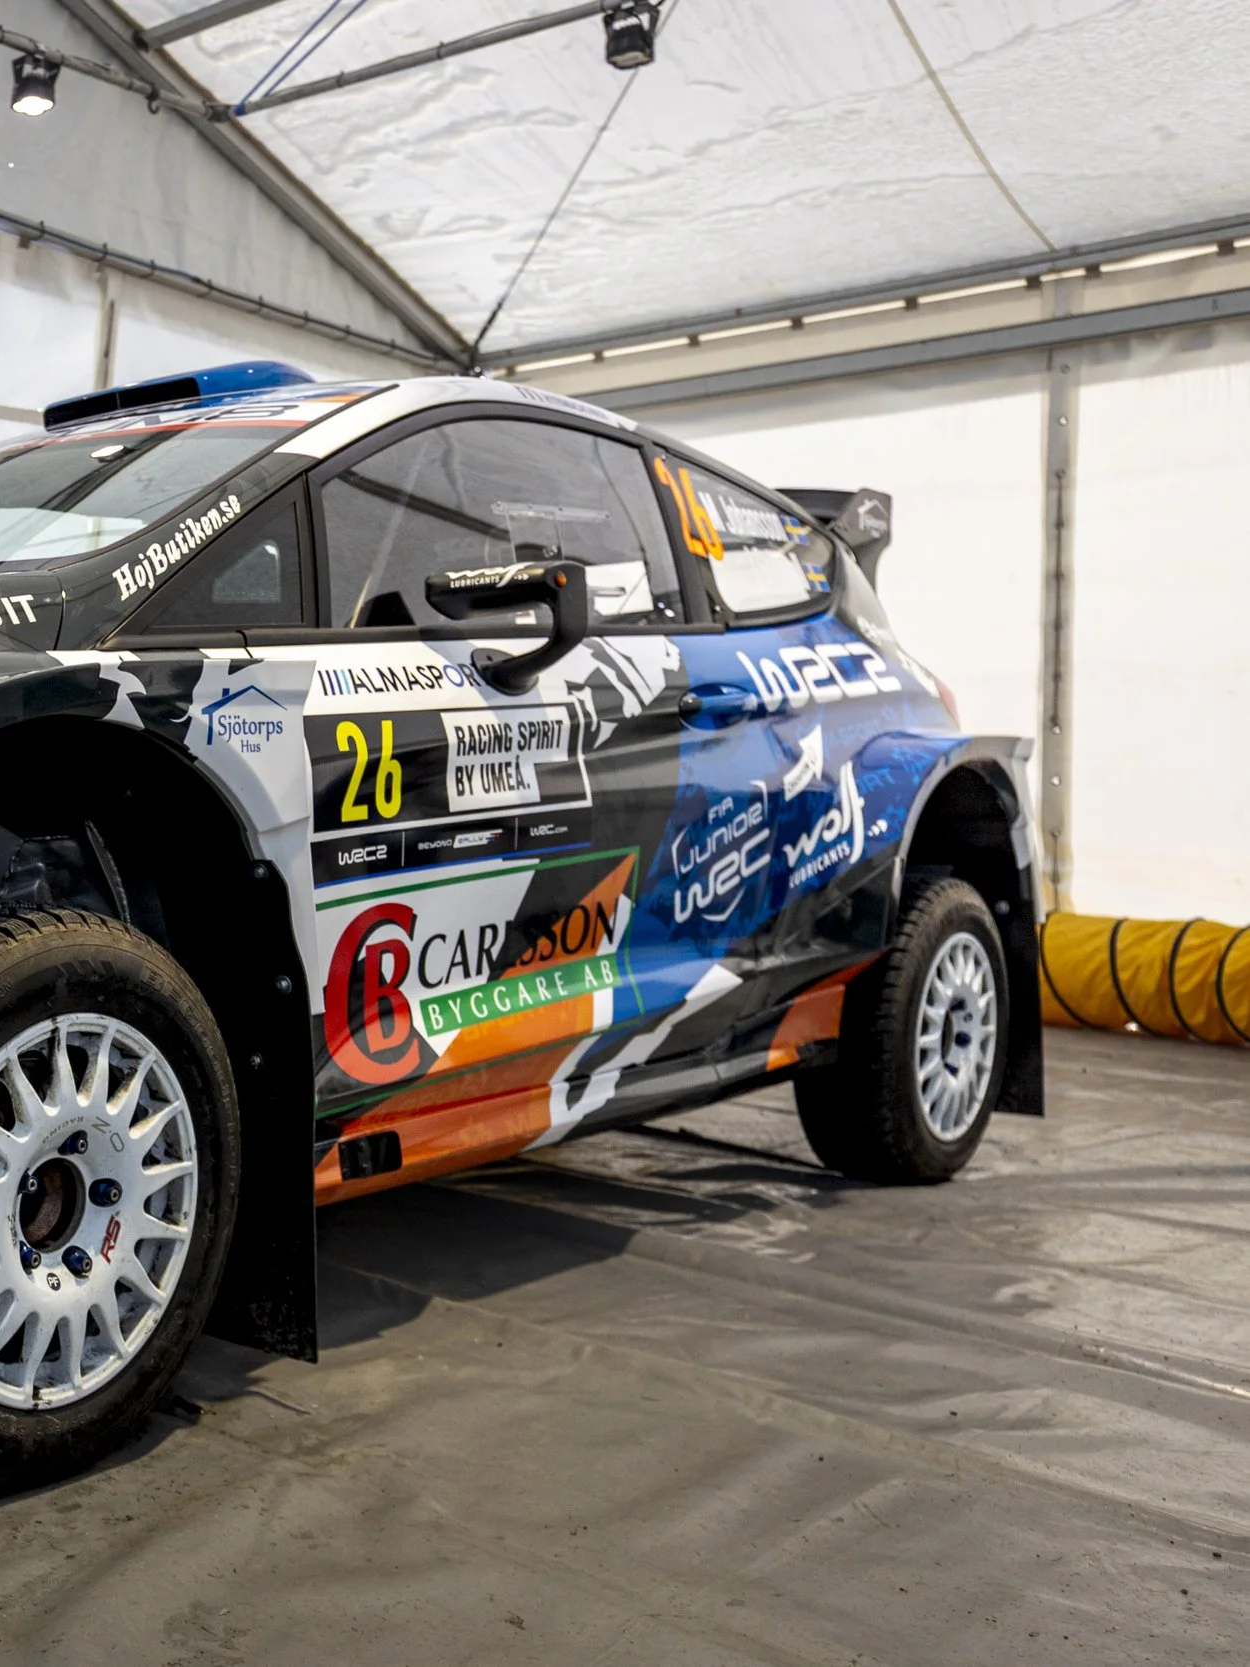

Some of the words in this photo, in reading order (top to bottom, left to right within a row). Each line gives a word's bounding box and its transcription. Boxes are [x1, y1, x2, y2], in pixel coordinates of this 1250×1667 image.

[112, 495, 241, 602] HojButiken.se
[450, 574, 500, 588] LUBRICANTS
[1, 594, 37, 625] IT
[350, 662, 488, 694] ALMASPOR
[217, 713, 283, 743] Sjötorps
[454, 723, 513, 757] RACING
[517, 719, 564, 752] SPIRIT
[240, 739, 261, 753] Hus
[335, 719, 403, 823] 26
[455, 764, 475, 797] BY
[708, 796, 734, 824] FIA
[679, 803, 763, 873] JUNIOR
[338, 845, 388, 866] WRC2
[789, 840, 850, 888] LUBRICANTS
[674, 828, 771, 924] WRC
[428, 972, 569, 1030] BYGGARE
[584, 961, 614, 989] AB
